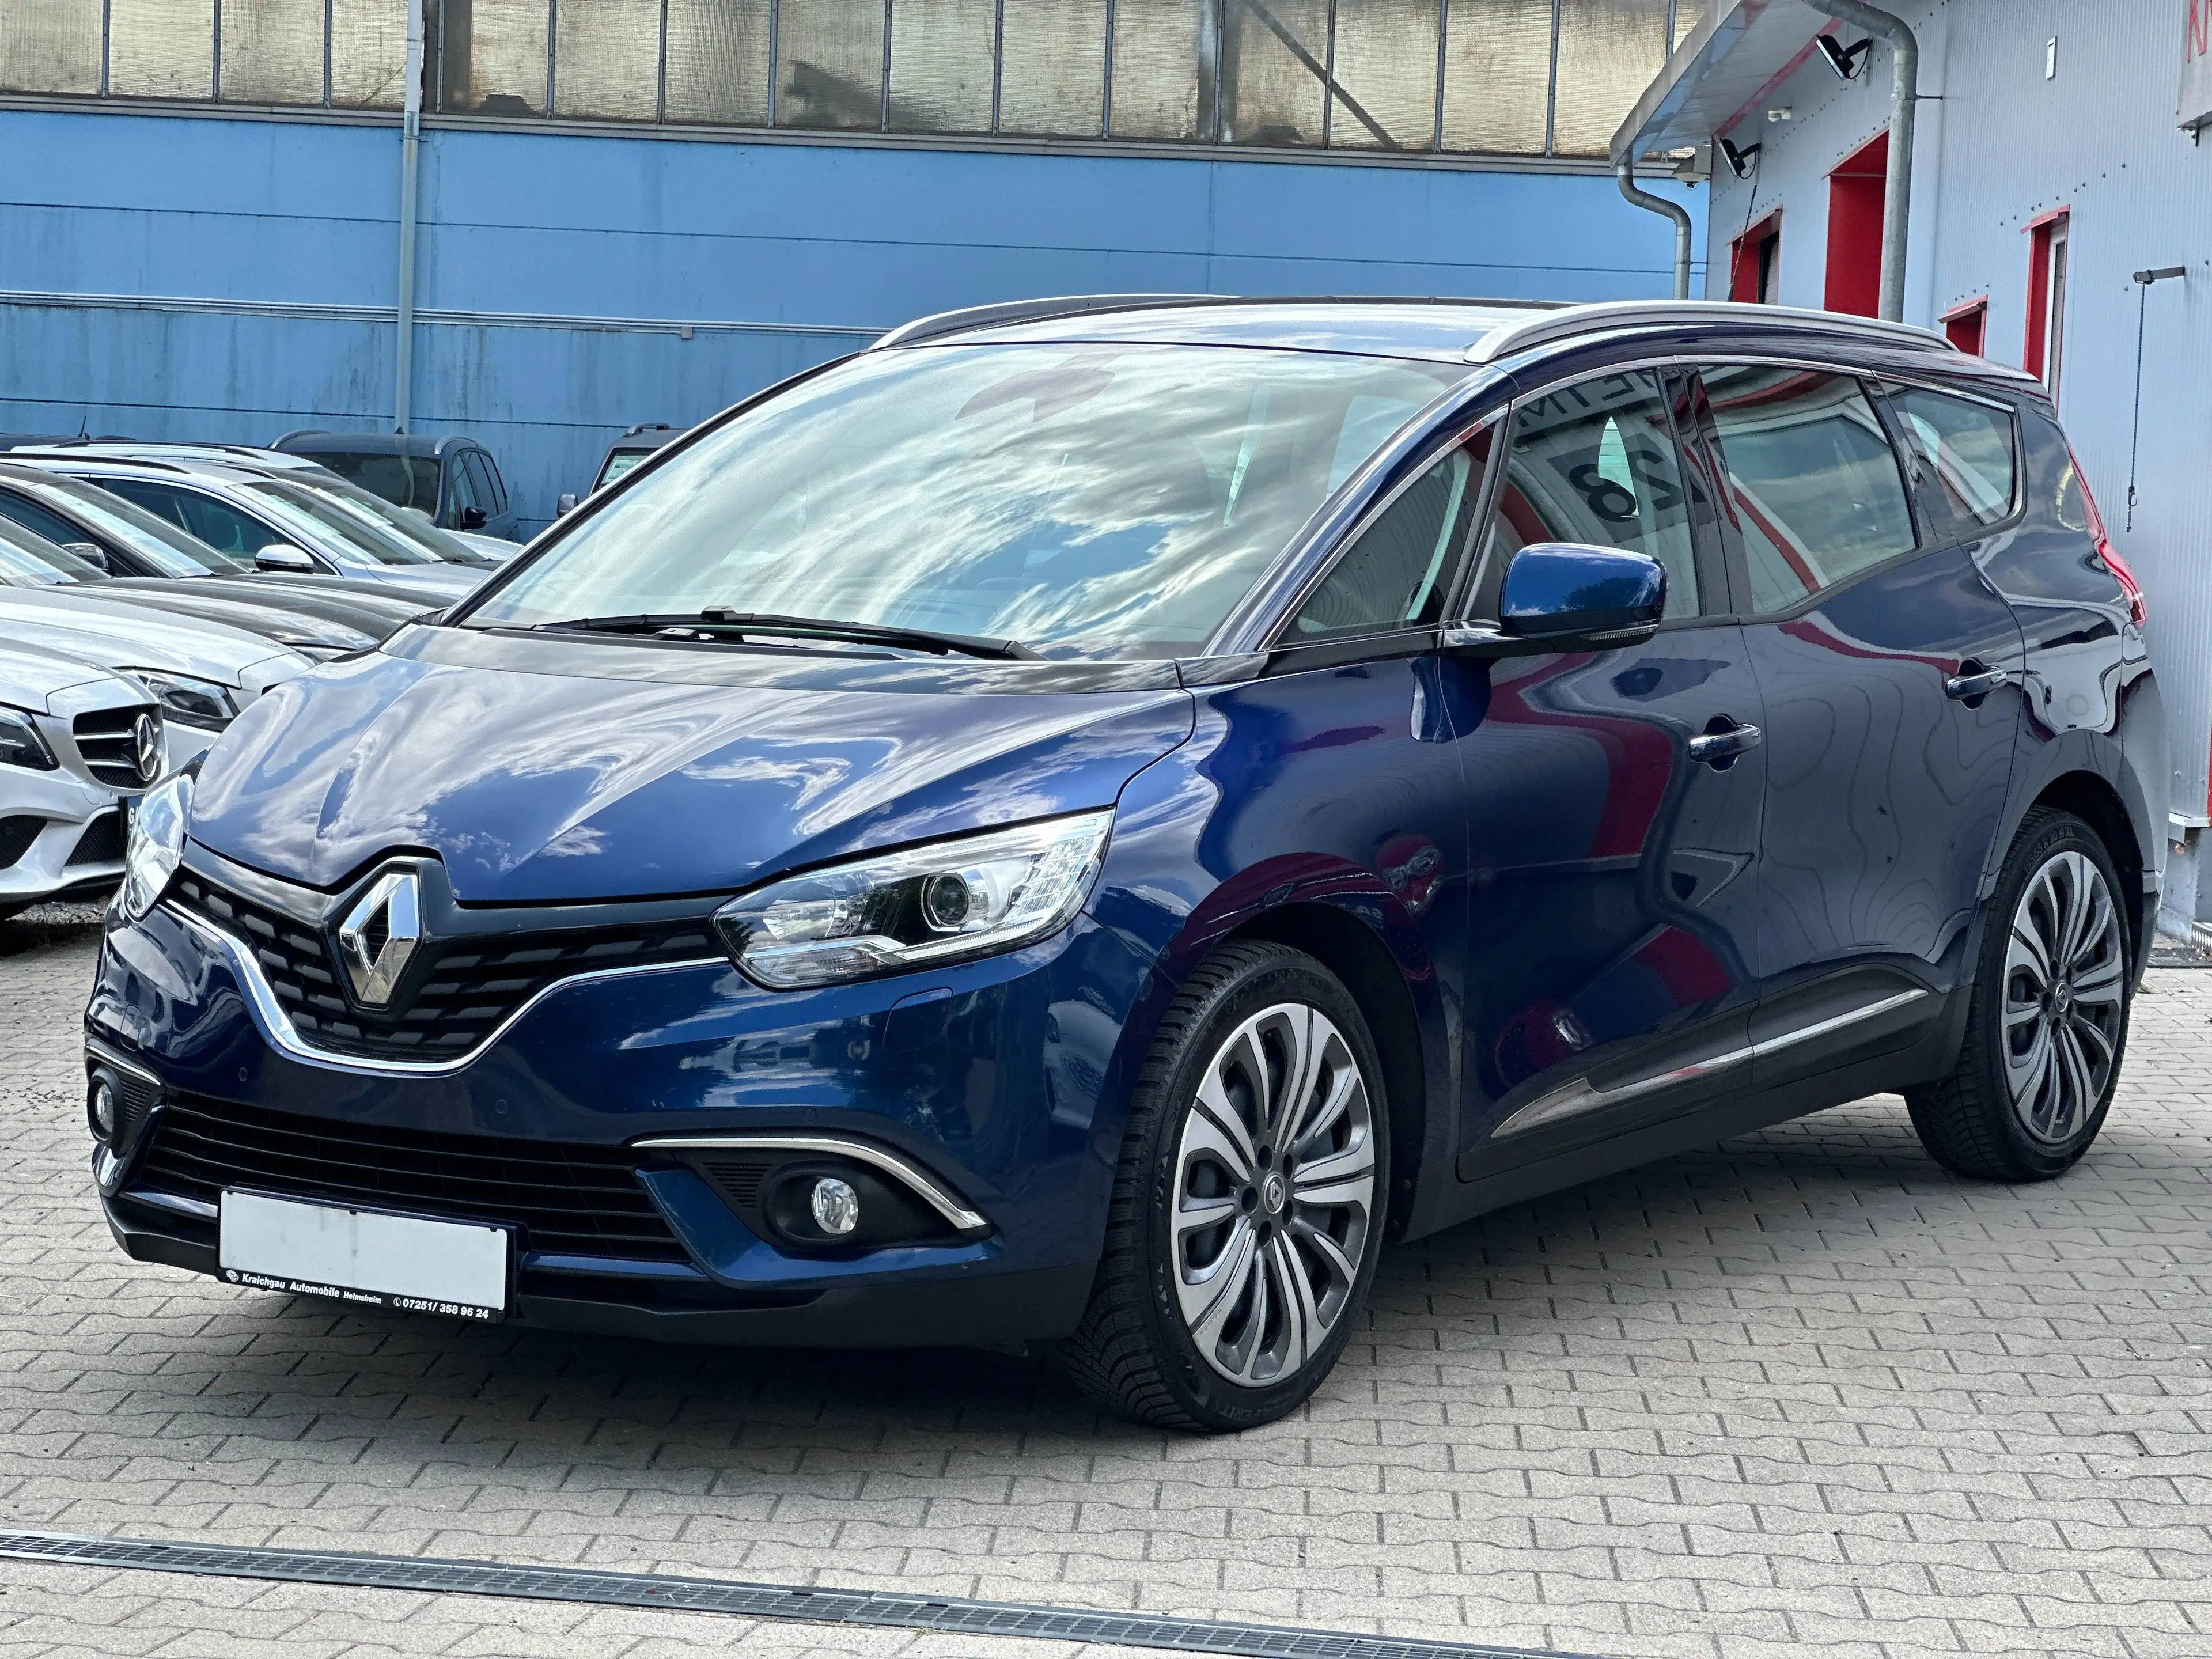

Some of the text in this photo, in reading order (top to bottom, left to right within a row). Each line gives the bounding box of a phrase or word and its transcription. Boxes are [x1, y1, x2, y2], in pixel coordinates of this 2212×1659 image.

[242, 1274, 285, 1289] Kraichgau
[290, 1282, 340, 1297] Automobile
[403, 1298, 437, 1312] 07251/
[440, 1304, 458, 1314] 358
[460, 1306, 474, 1316] 96
[476, 1308, 488, 1319] 24
